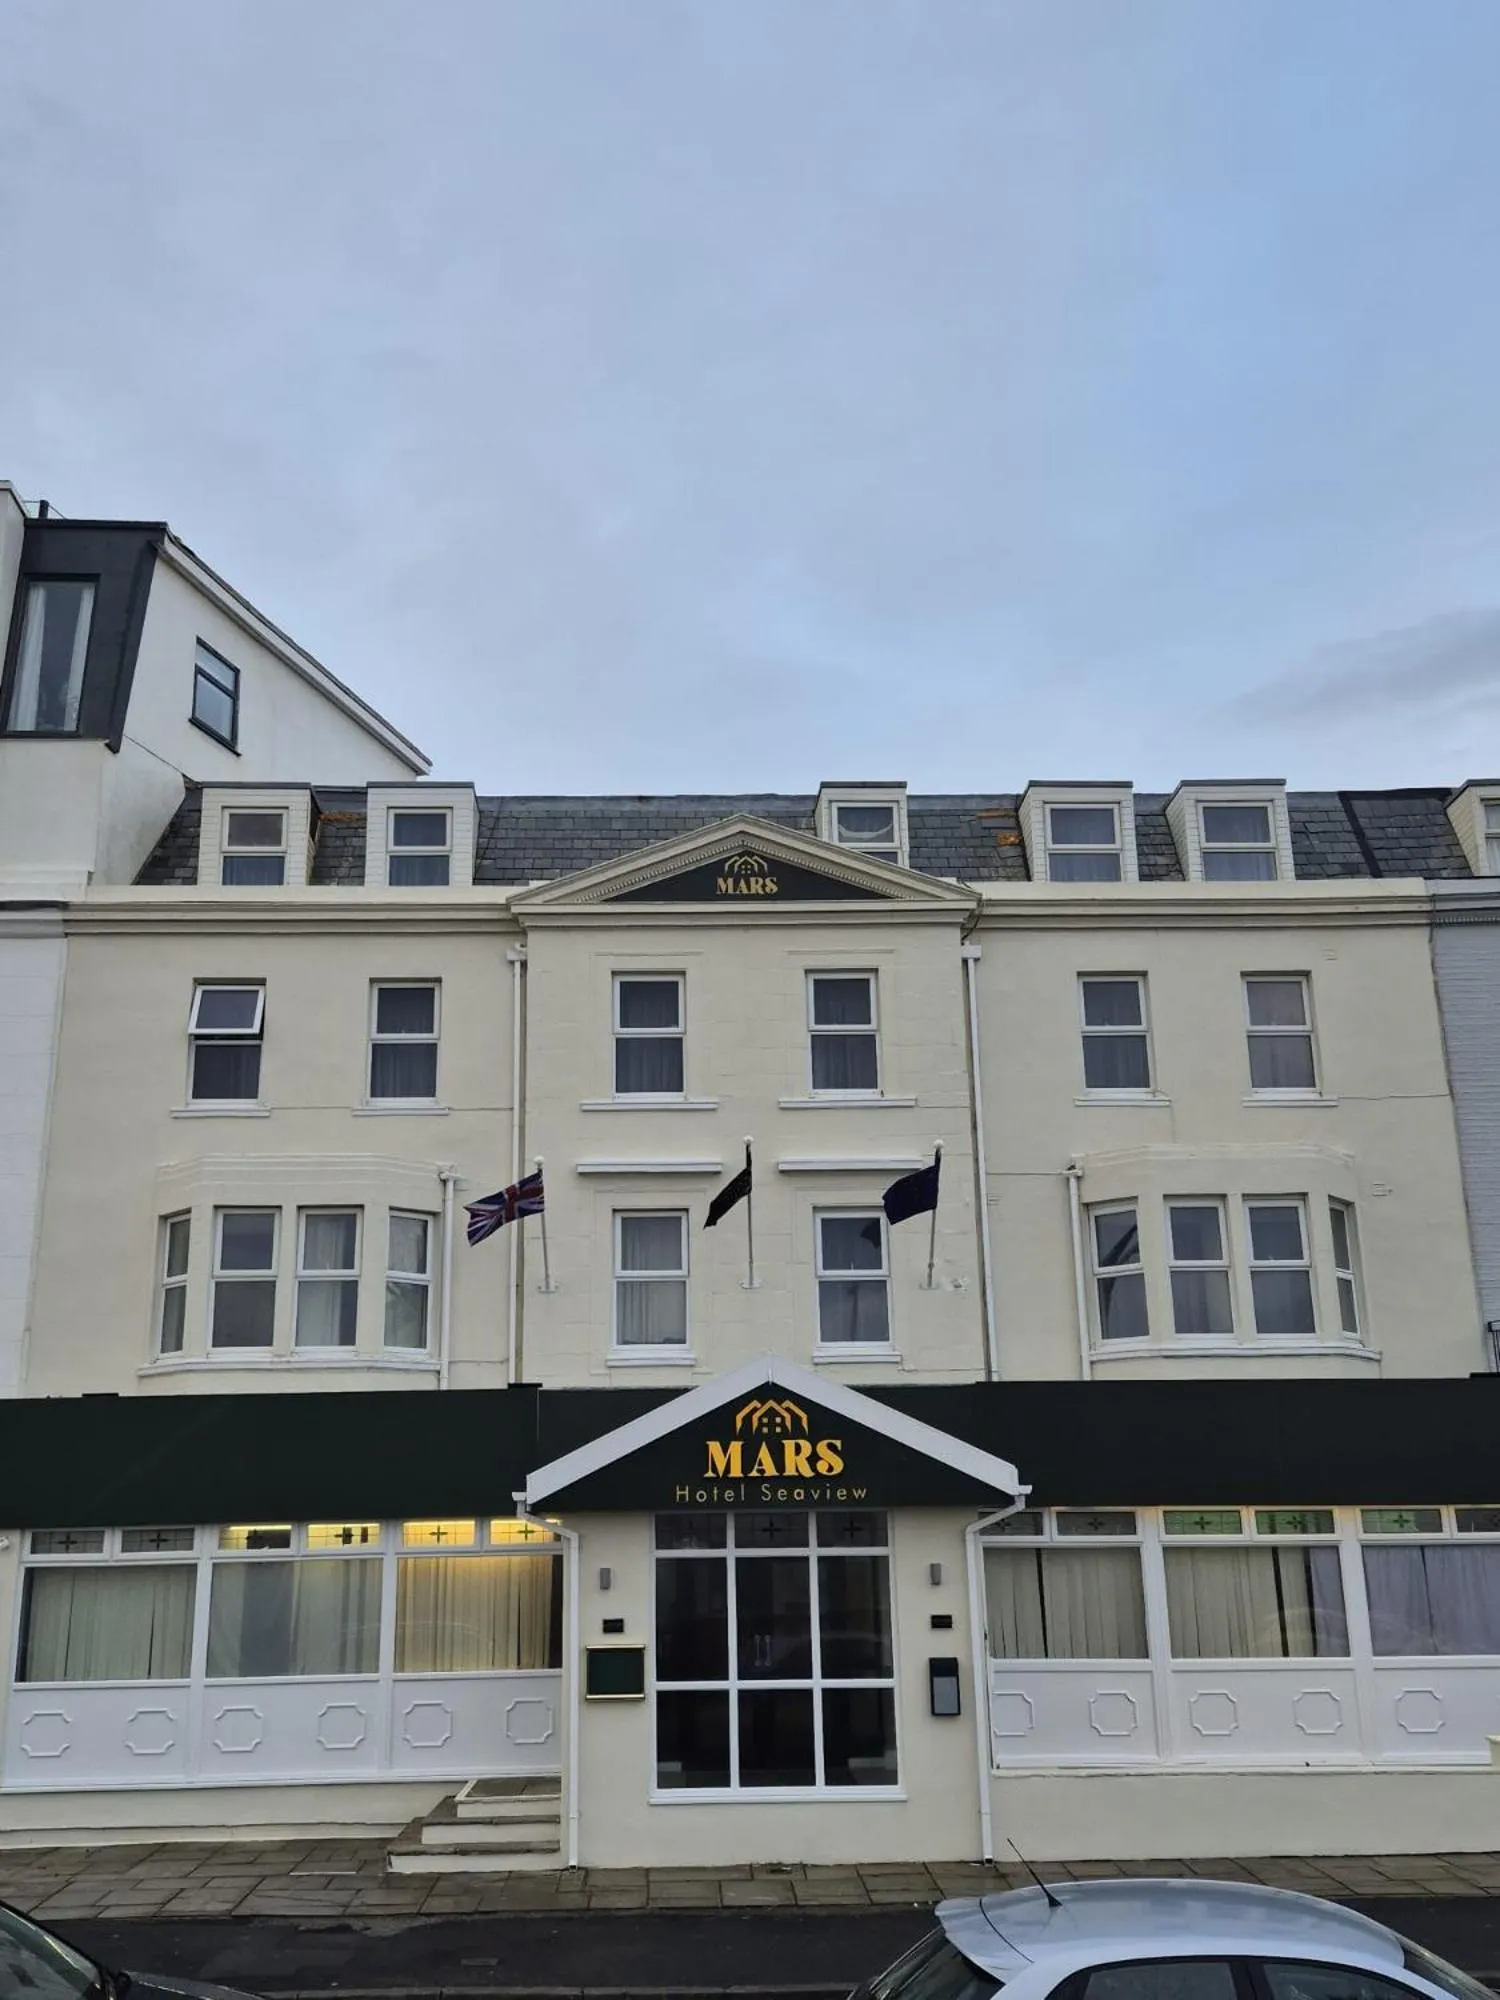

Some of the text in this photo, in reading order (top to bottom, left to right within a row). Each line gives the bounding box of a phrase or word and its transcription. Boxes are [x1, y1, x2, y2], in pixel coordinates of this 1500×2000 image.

[716, 876, 778, 895] MARS
[703, 1439, 844, 1478] MARS
[676, 1483, 867, 1502] Hotel Seaview
